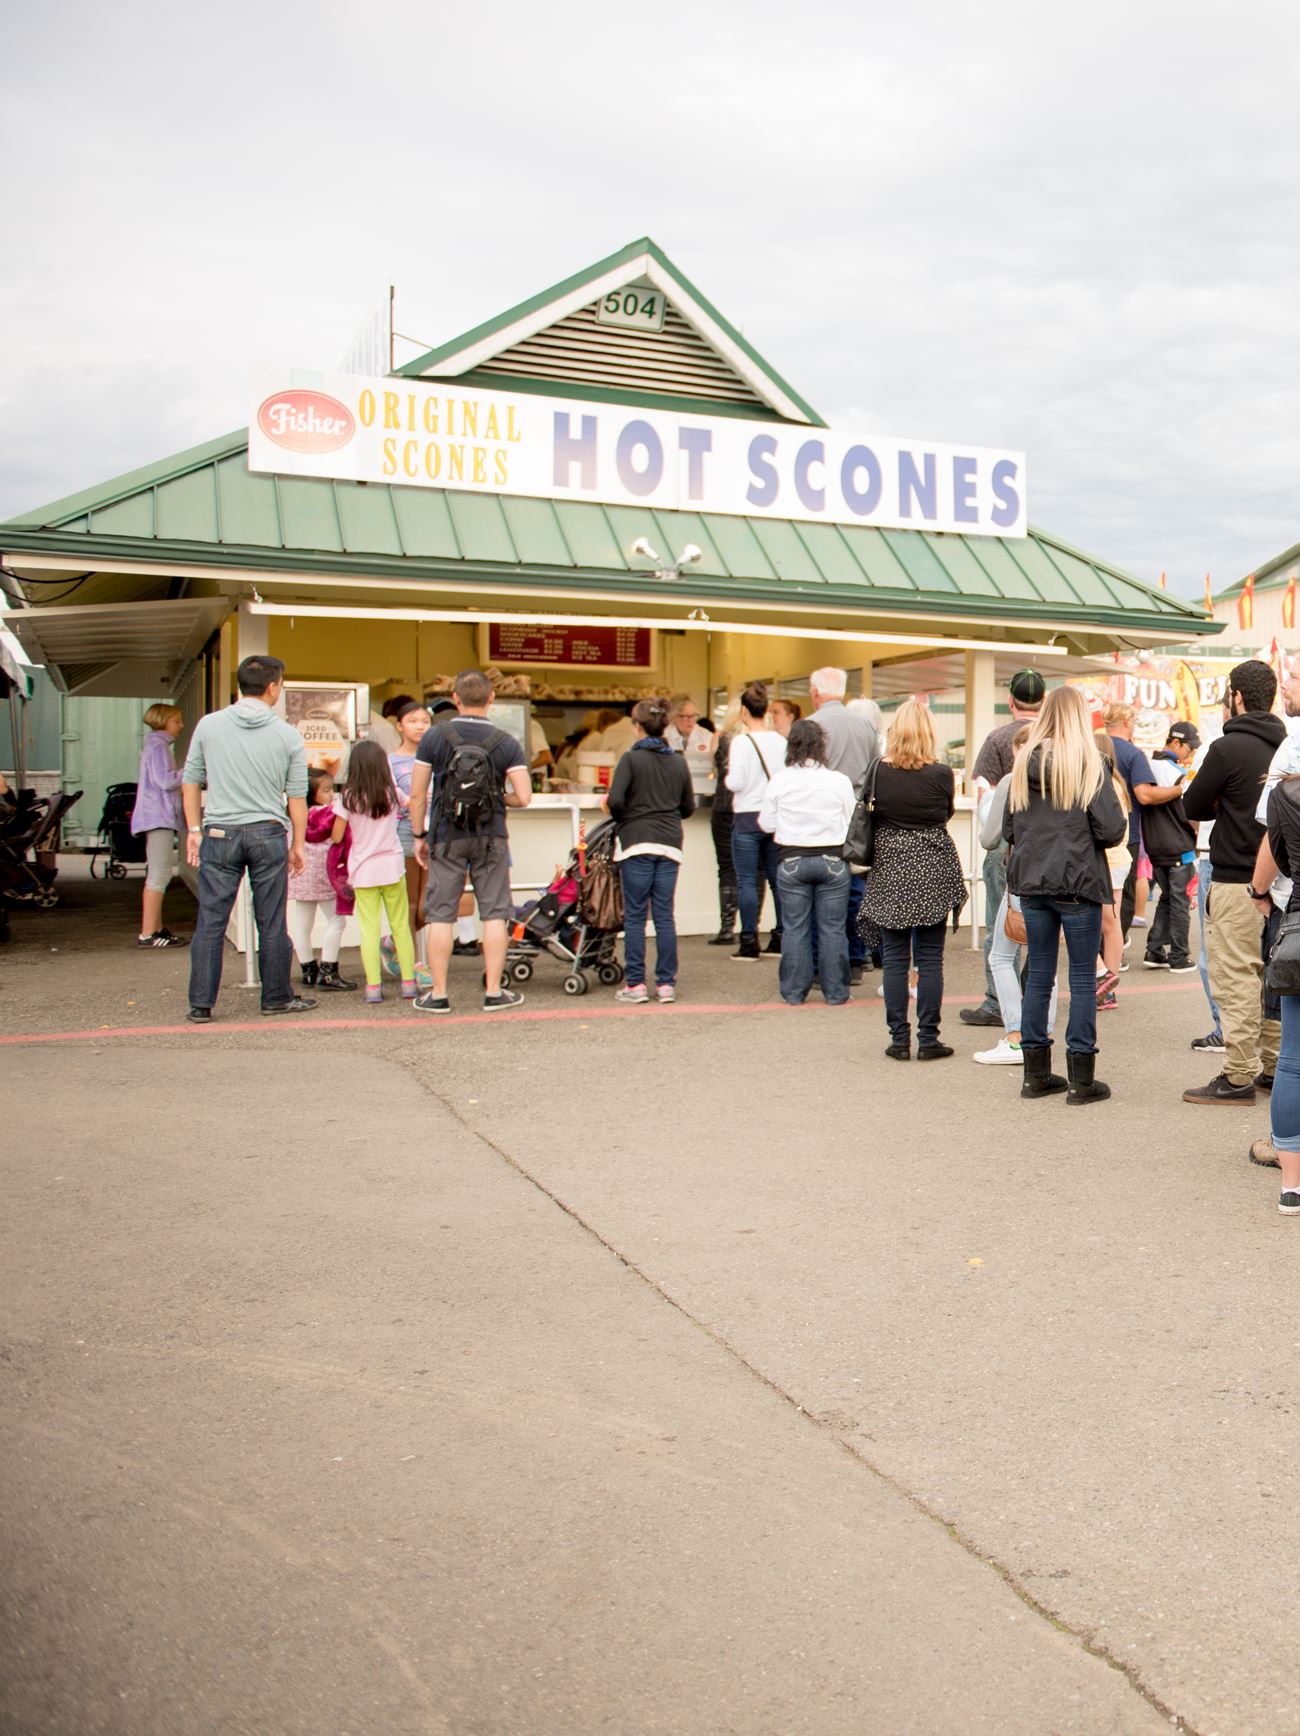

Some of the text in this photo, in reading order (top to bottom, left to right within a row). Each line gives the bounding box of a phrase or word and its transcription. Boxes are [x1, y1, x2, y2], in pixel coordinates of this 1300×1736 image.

[604, 291, 656, 319] 504
[268, 403, 347, 436] Fisher
[358, 388, 521, 442] ORIGINAL
[383, 437, 508, 485] SCONES
[553, 411, 1020, 528] HOT SCONES
[303, 732, 336, 741] OFFEE
